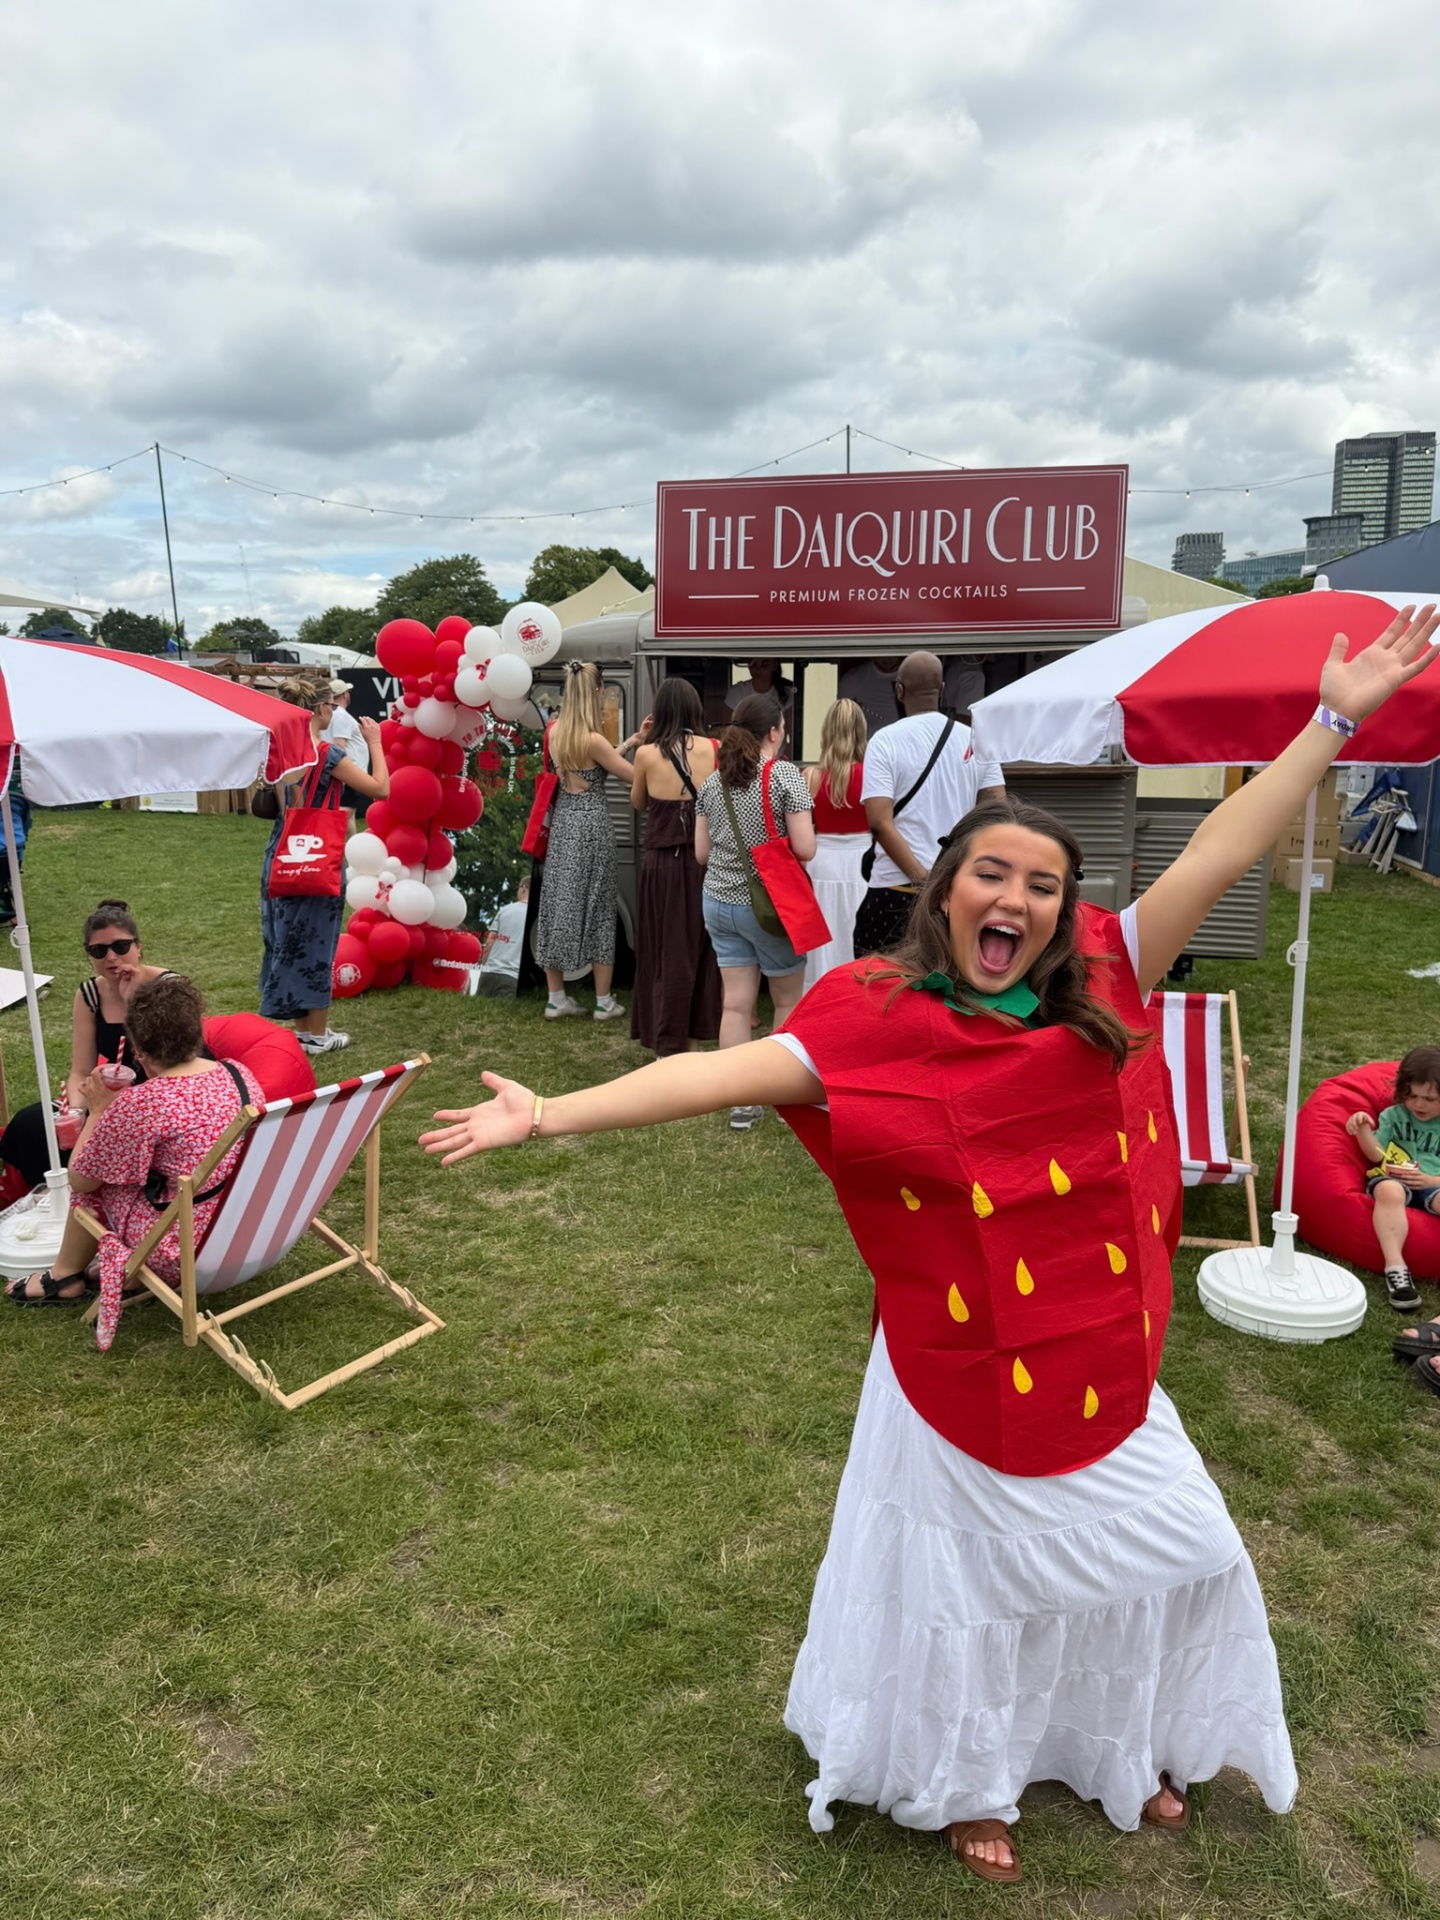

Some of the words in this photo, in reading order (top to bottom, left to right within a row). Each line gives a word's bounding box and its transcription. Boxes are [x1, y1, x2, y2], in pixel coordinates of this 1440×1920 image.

[682, 508, 756, 571] THE
[773, 505, 971, 577] DAIQUIRI
[986, 497, 1099, 563] CLUB
[770, 590, 840, 603] PREMIUM
[848, 588, 910, 601] FROZEN
[918, 585, 1008, 599] COCKTAILS
[372, 677, 402, 699] VI
[507, 781, 515, 793] UK
